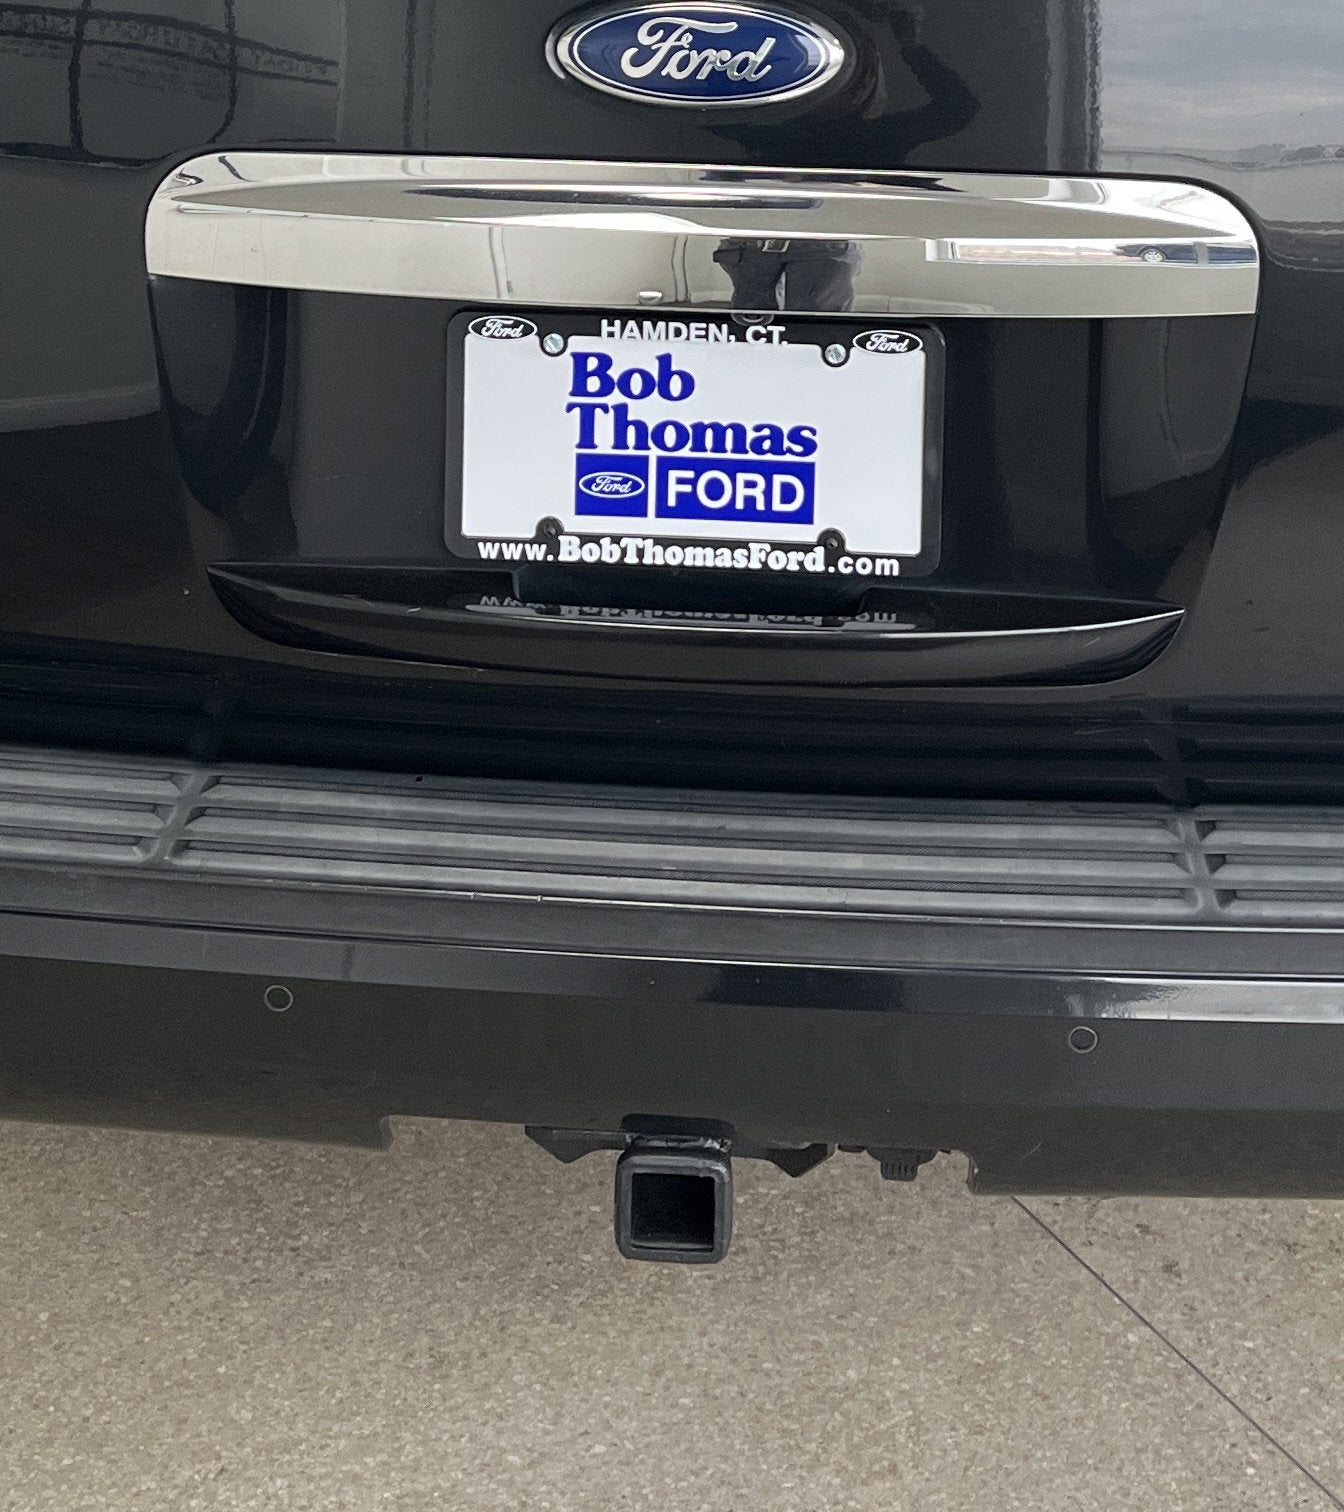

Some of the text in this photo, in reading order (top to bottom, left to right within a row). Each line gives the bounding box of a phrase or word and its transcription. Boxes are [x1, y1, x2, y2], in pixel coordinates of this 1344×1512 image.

[620, 16, 777, 82] Ford
[480, 318, 525, 338] Ford
[600, 319, 789, 346] HAMDEN, CT.
[865, 332, 910, 353] Ford
[568, 351, 696, 402] Bob
[565, 402, 819, 458] Thomas
[666, 469, 806, 513] FORD
[477, 535, 901, 577] www.BobThomasFord.com
